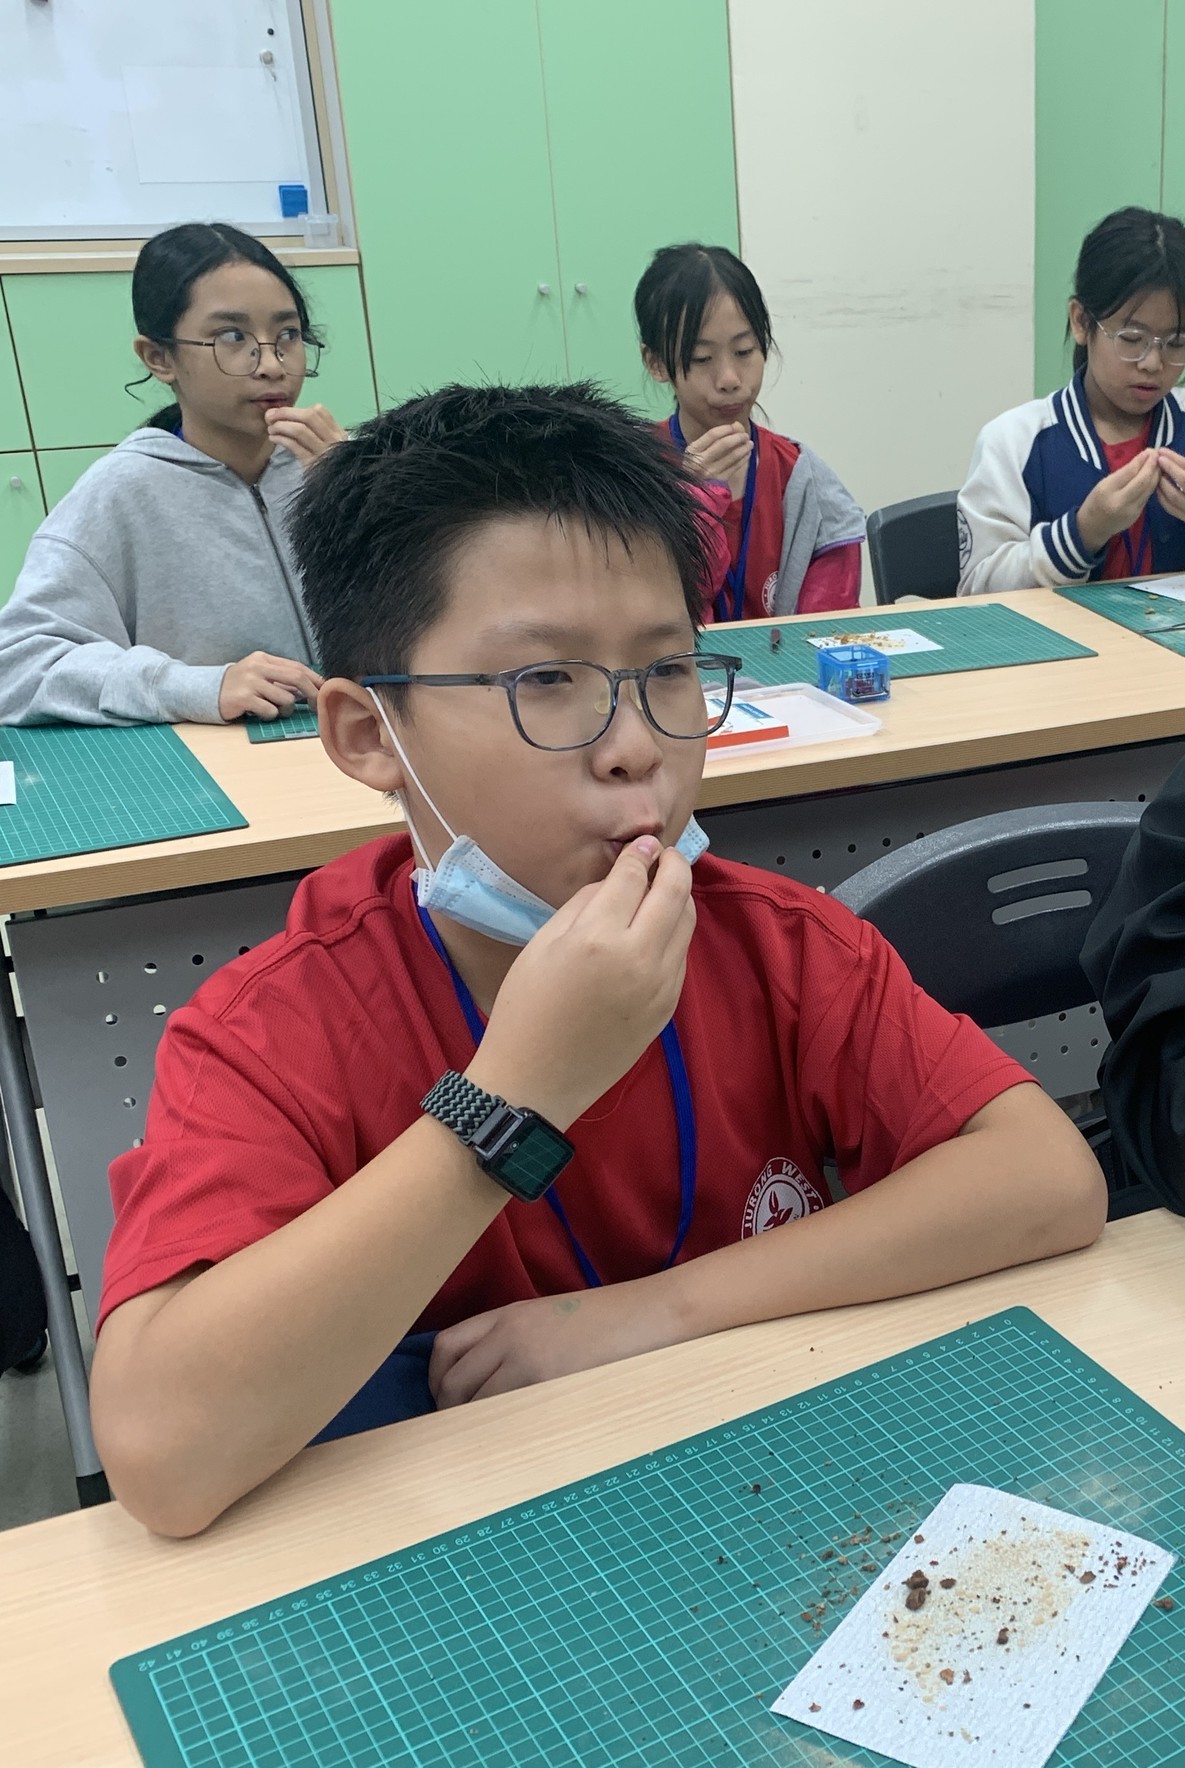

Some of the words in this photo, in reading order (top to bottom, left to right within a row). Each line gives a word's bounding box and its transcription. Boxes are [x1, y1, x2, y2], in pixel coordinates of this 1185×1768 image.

[744, 1164, 773, 1229] JURONG
[781, 1161, 817, 1199] WEST
[1136, 1416, 1148, 1425] 10
[1149, 1428, 1160, 1436] 11
[1162, 1437, 1174, 1446] 12
[138, 1660, 155, 1671] 42
[166, 1649, 182, 1660] 41
[191, 1639, 208, 1650] 40
[217, 1628, 234, 1640] 39
[242, 1618, 259, 1630] 38
[269, 1609, 284, 1621] 37
[291, 1599, 308, 1610] 36
[315, 1589, 332, 1601] 35
[340, 1580, 356, 1591] 34
[363, 1571, 380, 1582] 33
[386, 1562, 403, 1573] 32
[411, 1553, 426, 1563] 31
[432, 1544, 448, 1554] 30
[455, 1535, 471, 1545] 29
[477, 1526, 492, 1537] 28
[501, 1517, 514, 1529] 27
[520, 1509, 536, 1520] 26
[542, 1501, 557, 1511] 25
[563, 1492, 578, 1503] 24
[584, 1484, 599, 1495] 23
[604, 1476, 620, 1486] 22
[626, 1469, 640, 1478] 21
[645, 1461, 660, 1471] 20
[665, 1454, 679, 1462] 19
[685, 1446, 698, 1455] 18
[706, 1438, 717, 1447] 17
[723, 1431, 736, 1439] 16
[742, 1423, 755, 1432] 15
[761, 1416, 774, 1424] 14
[779, 1408, 792, 1416] 13
[797, 1401, 811, 1409] 12
[834, 1386, 846, 1394] 10
